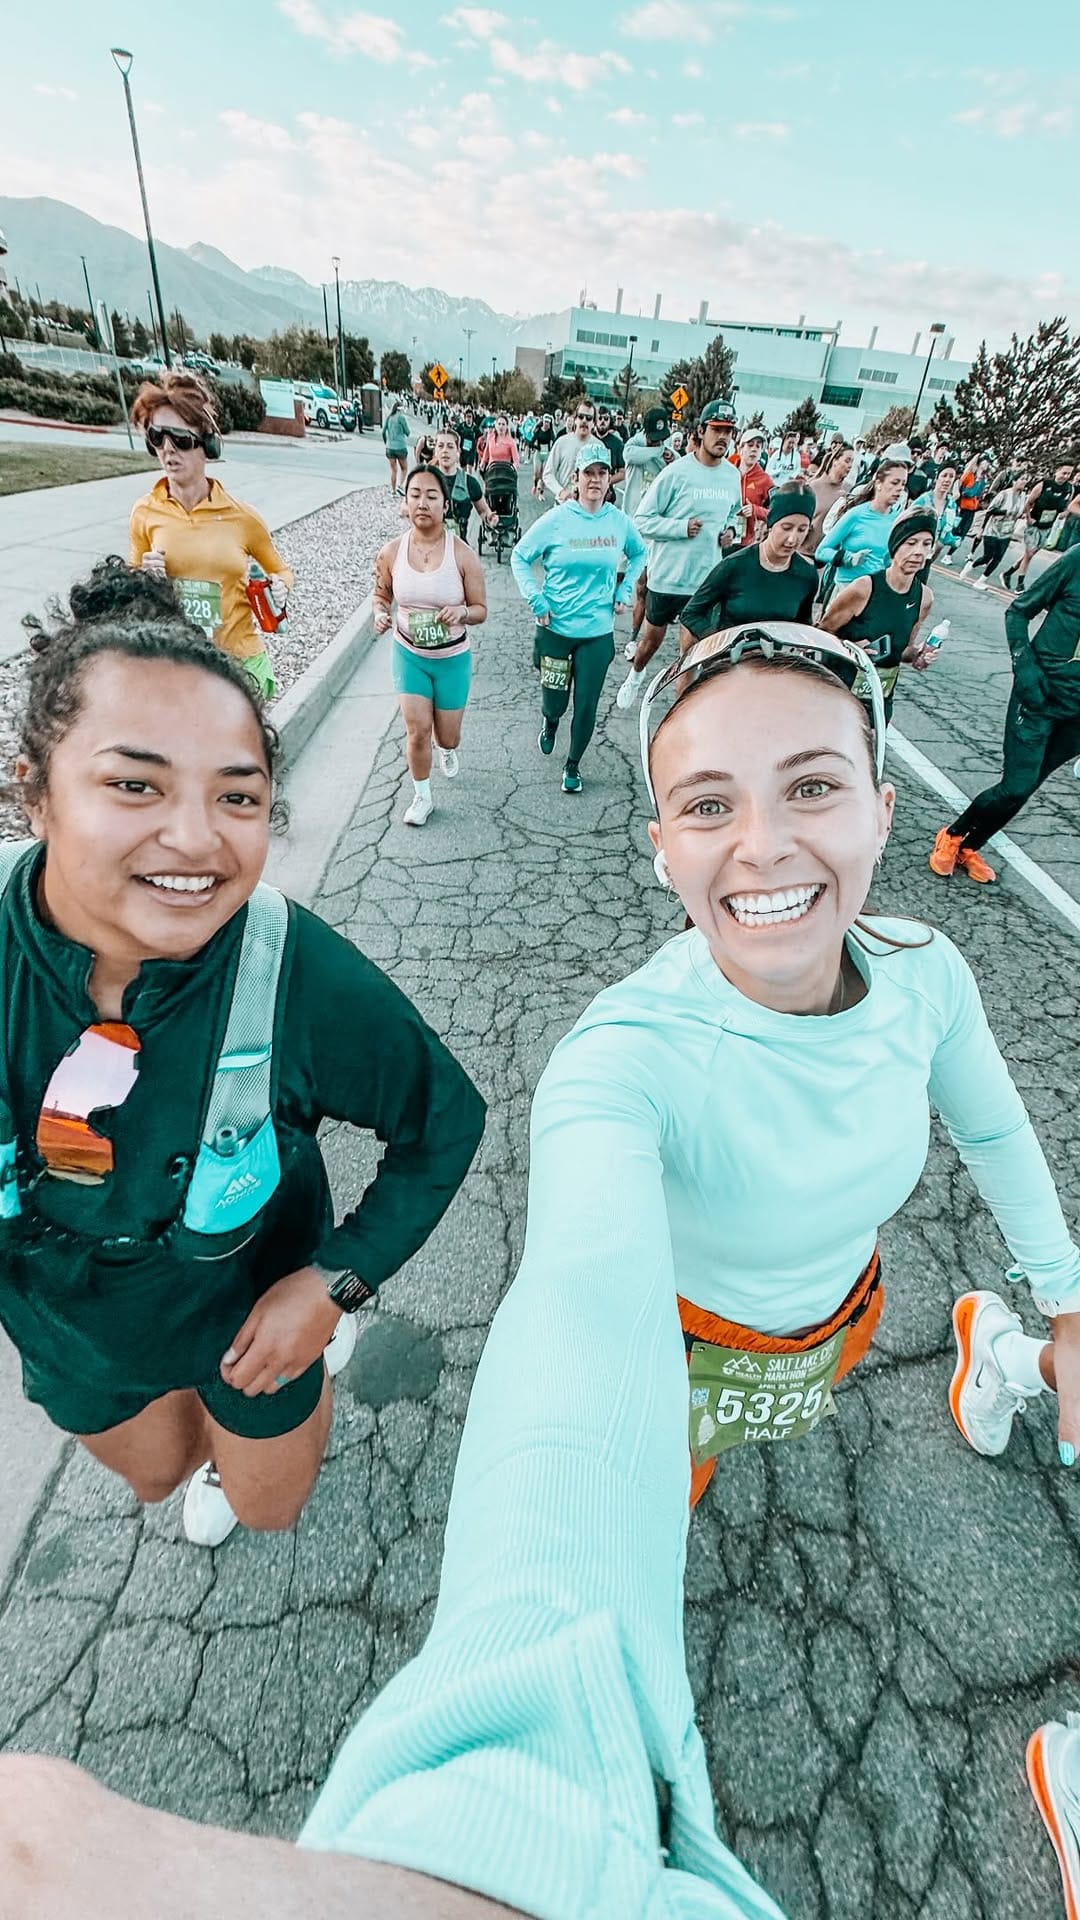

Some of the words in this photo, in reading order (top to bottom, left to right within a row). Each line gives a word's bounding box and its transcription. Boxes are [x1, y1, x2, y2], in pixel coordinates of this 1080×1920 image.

[180, 599, 212, 619] 228
[417, 625, 444, 641] 2794
[544, 671, 567, 686] 2872
[767, 1357, 794, 1371] SALT
[795, 1352, 820, 1370] LAKE
[764, 1369, 807, 1381] MARATHON
[716, 1379, 825, 1425] 5325
[744, 1427, 792, 1440] HALF
